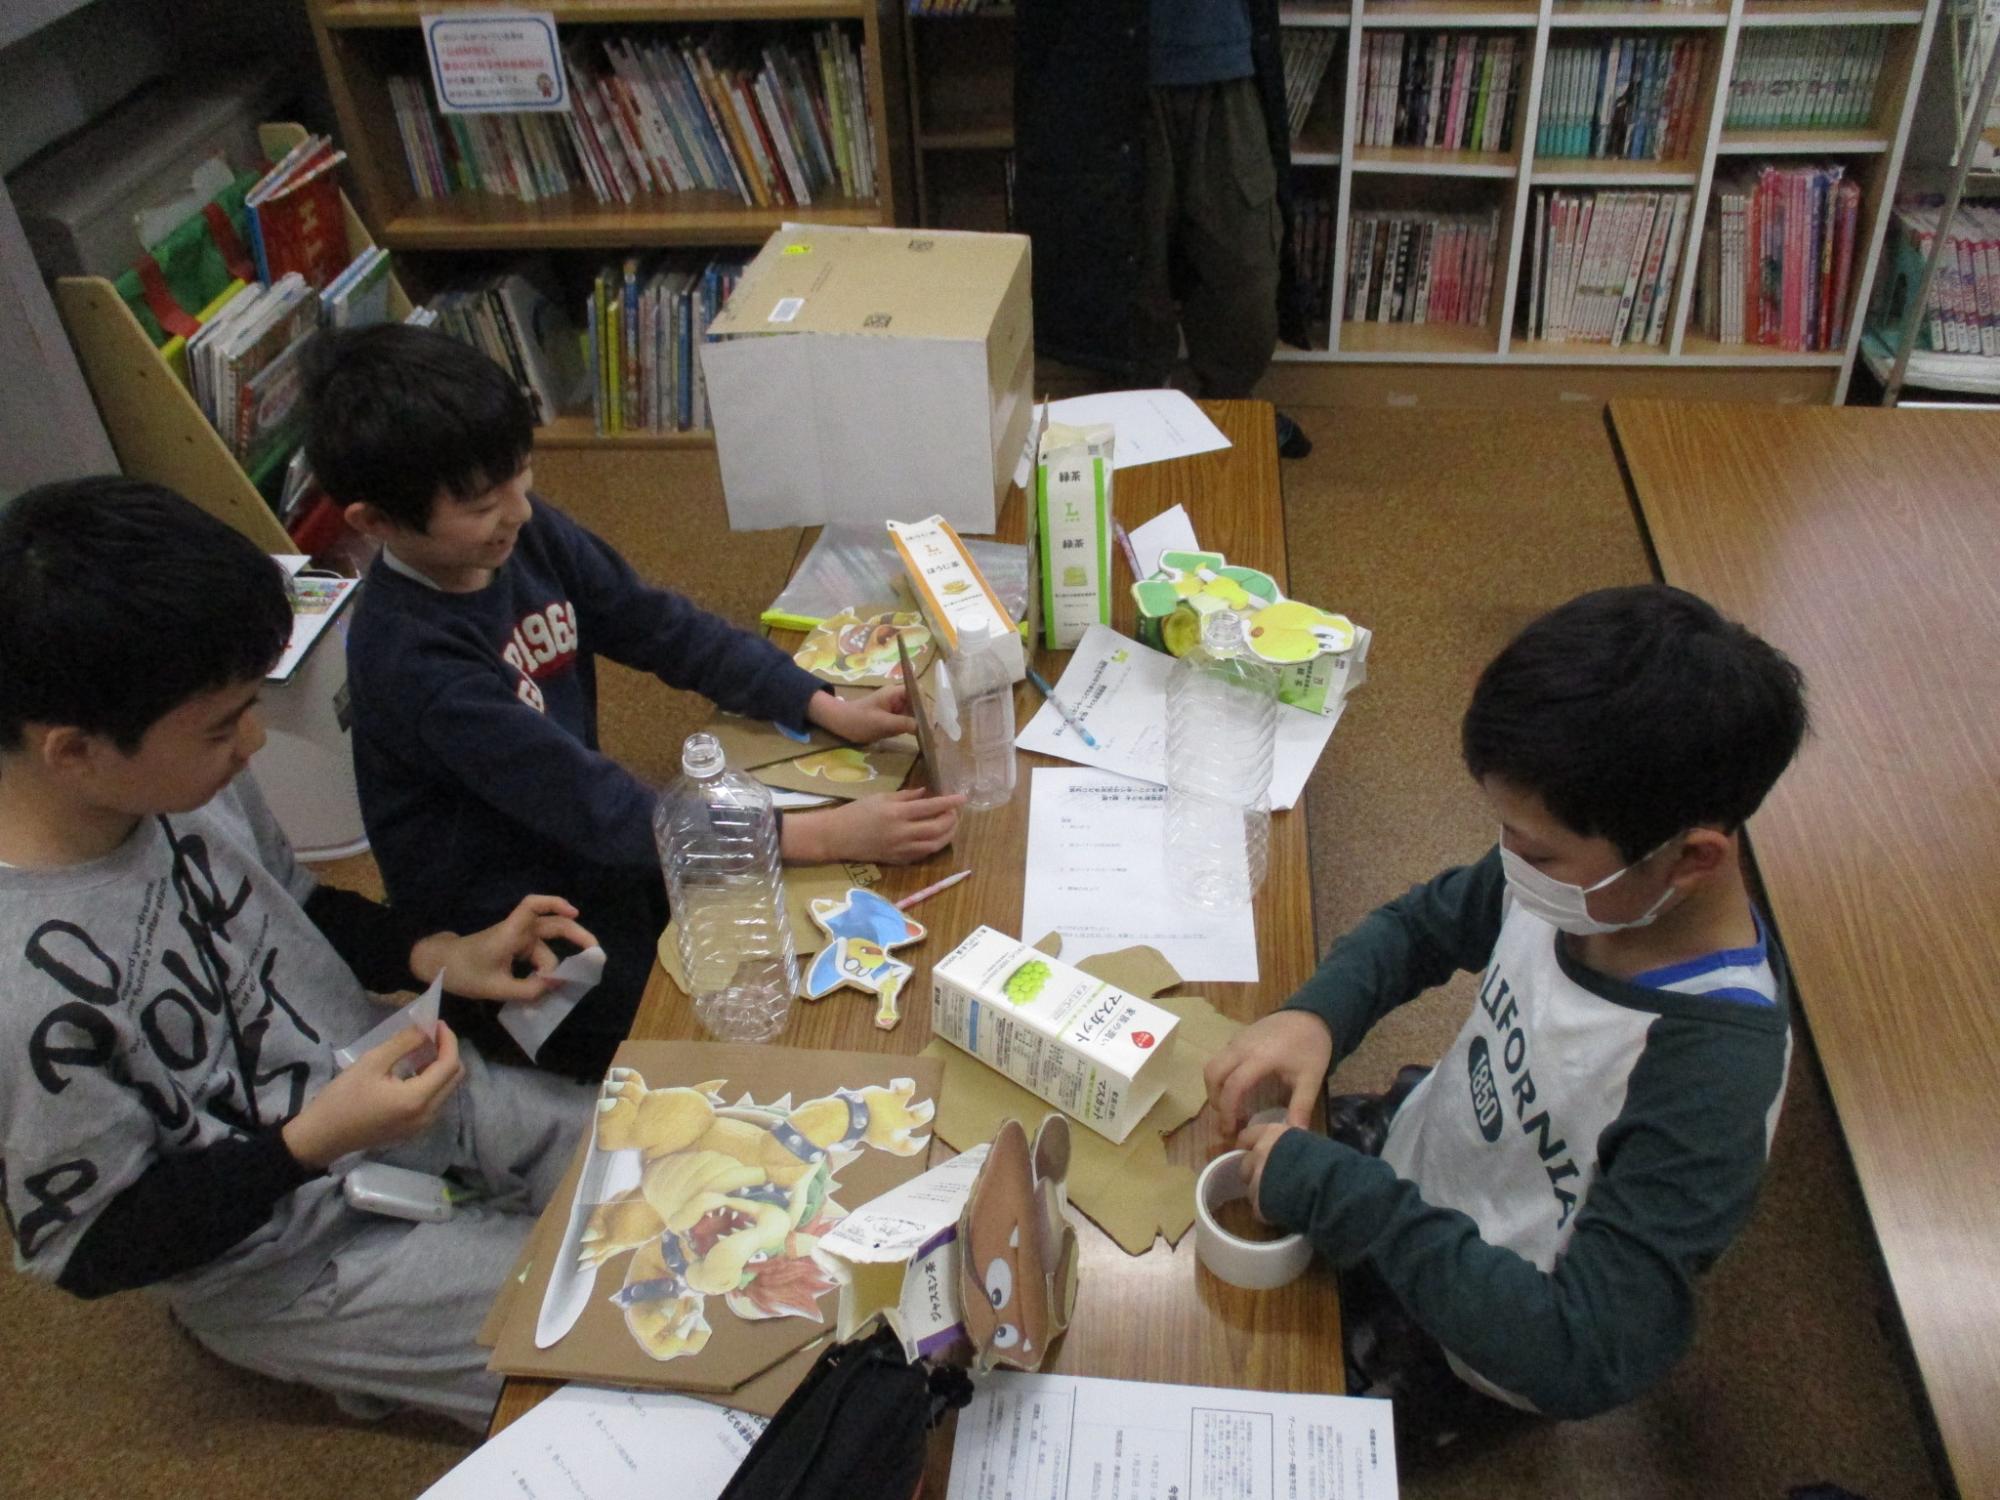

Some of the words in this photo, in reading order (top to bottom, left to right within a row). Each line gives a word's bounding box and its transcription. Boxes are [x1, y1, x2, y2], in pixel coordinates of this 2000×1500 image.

[1059, 470, 1081, 483] 緑茶
[1062, 538, 1085, 549] 緑茶
[927, 560, 961, 575] ほうじ茶
[1074, 993, 1124, 1045] マスカット
[1095, 1079, 1108, 1121] マスカット
[1471, 1052, 1499, 1128] 1850
[924, 1261, 943, 1323] ジャスミン茶
